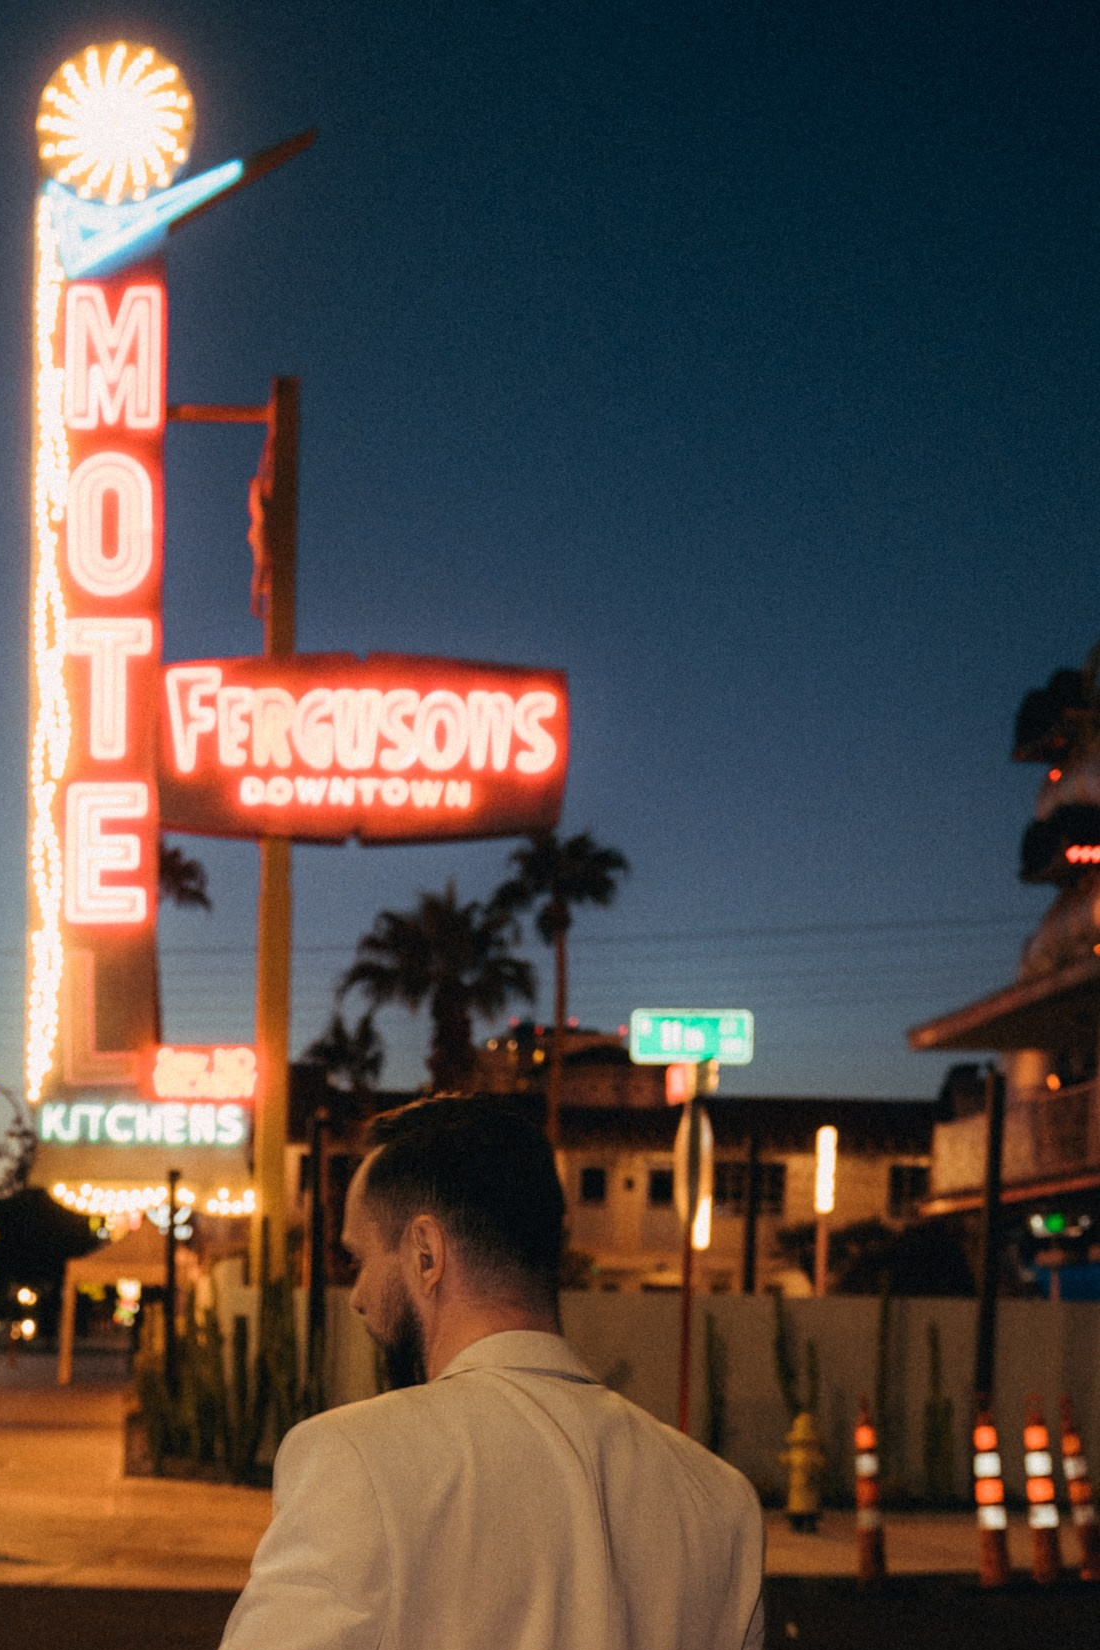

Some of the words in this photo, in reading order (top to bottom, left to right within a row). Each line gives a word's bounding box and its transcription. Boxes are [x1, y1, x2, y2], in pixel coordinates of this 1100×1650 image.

[63, 283, 163, 1086] MOTEL
[165, 666, 558, 774] FERGUSONS
[240, 775, 471, 809] DOWNTOWN
[41, 1103, 245, 1143] KITCHENS
